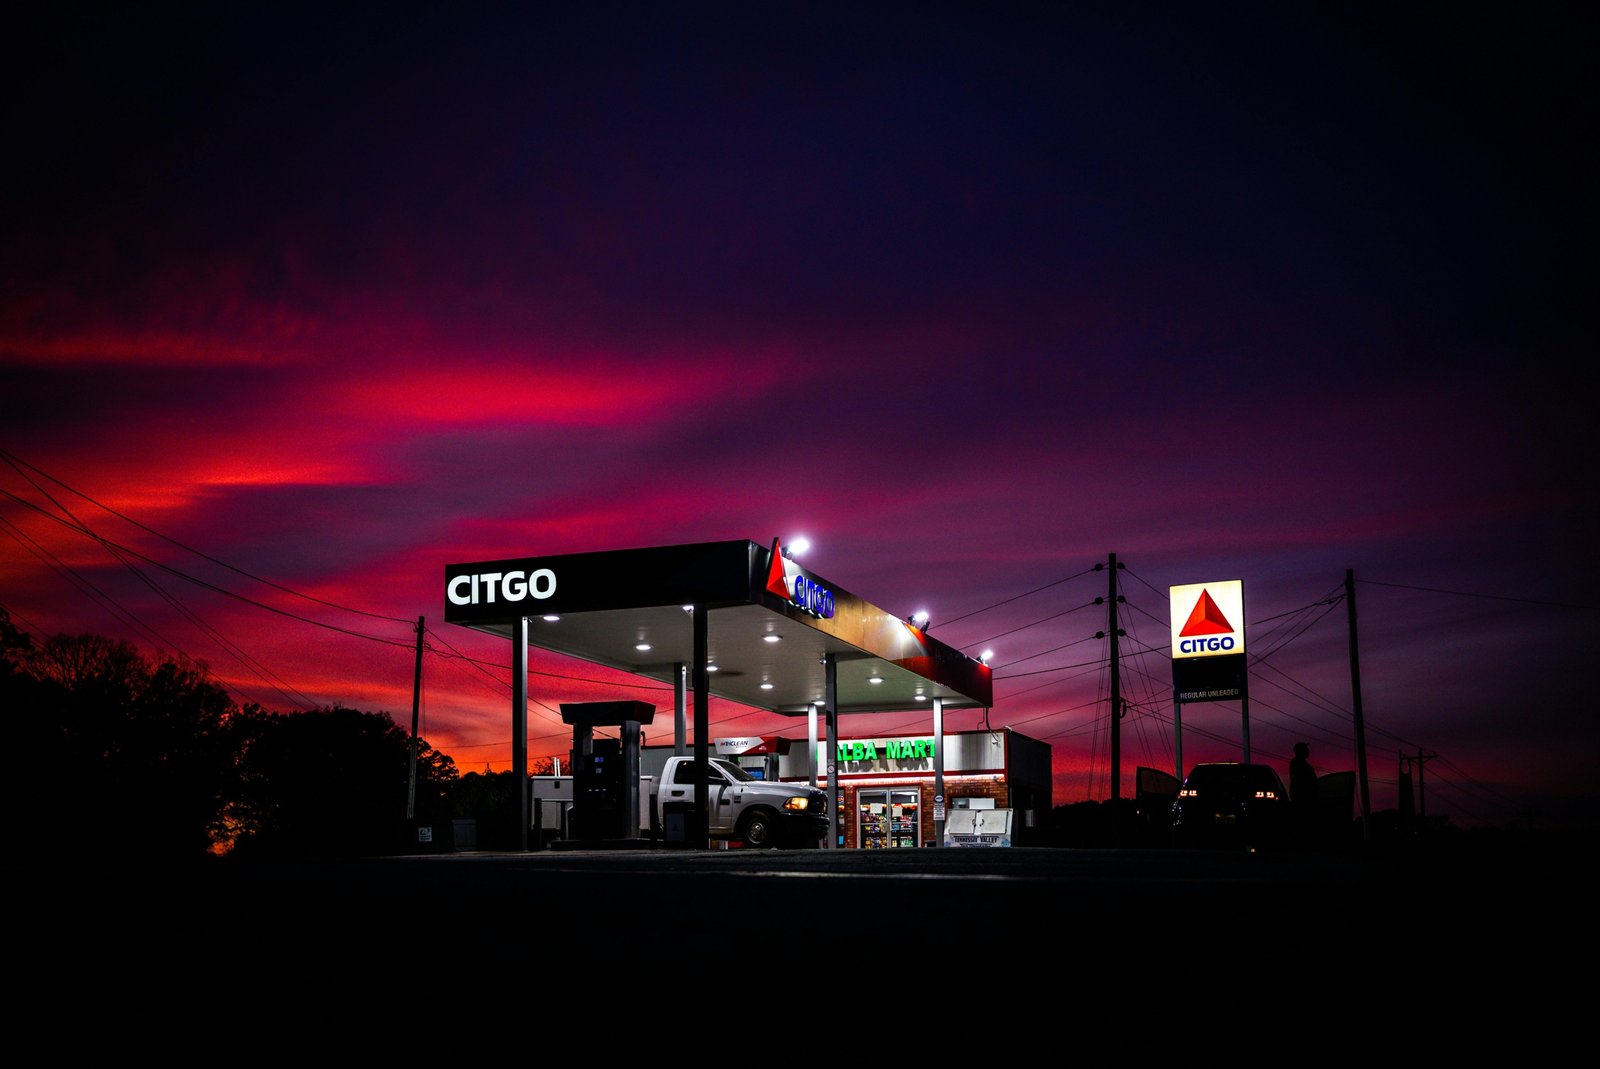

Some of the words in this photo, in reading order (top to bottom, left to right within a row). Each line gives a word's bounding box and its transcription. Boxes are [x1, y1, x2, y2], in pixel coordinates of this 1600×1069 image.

[447, 568, 557, 605] CITGO
[794, 575, 834, 619] CITGO
[1180, 637, 1234, 653] CITGO
[1208, 689, 1239, 697] UNLEADED
[979, 835, 999, 843] VALLEY
